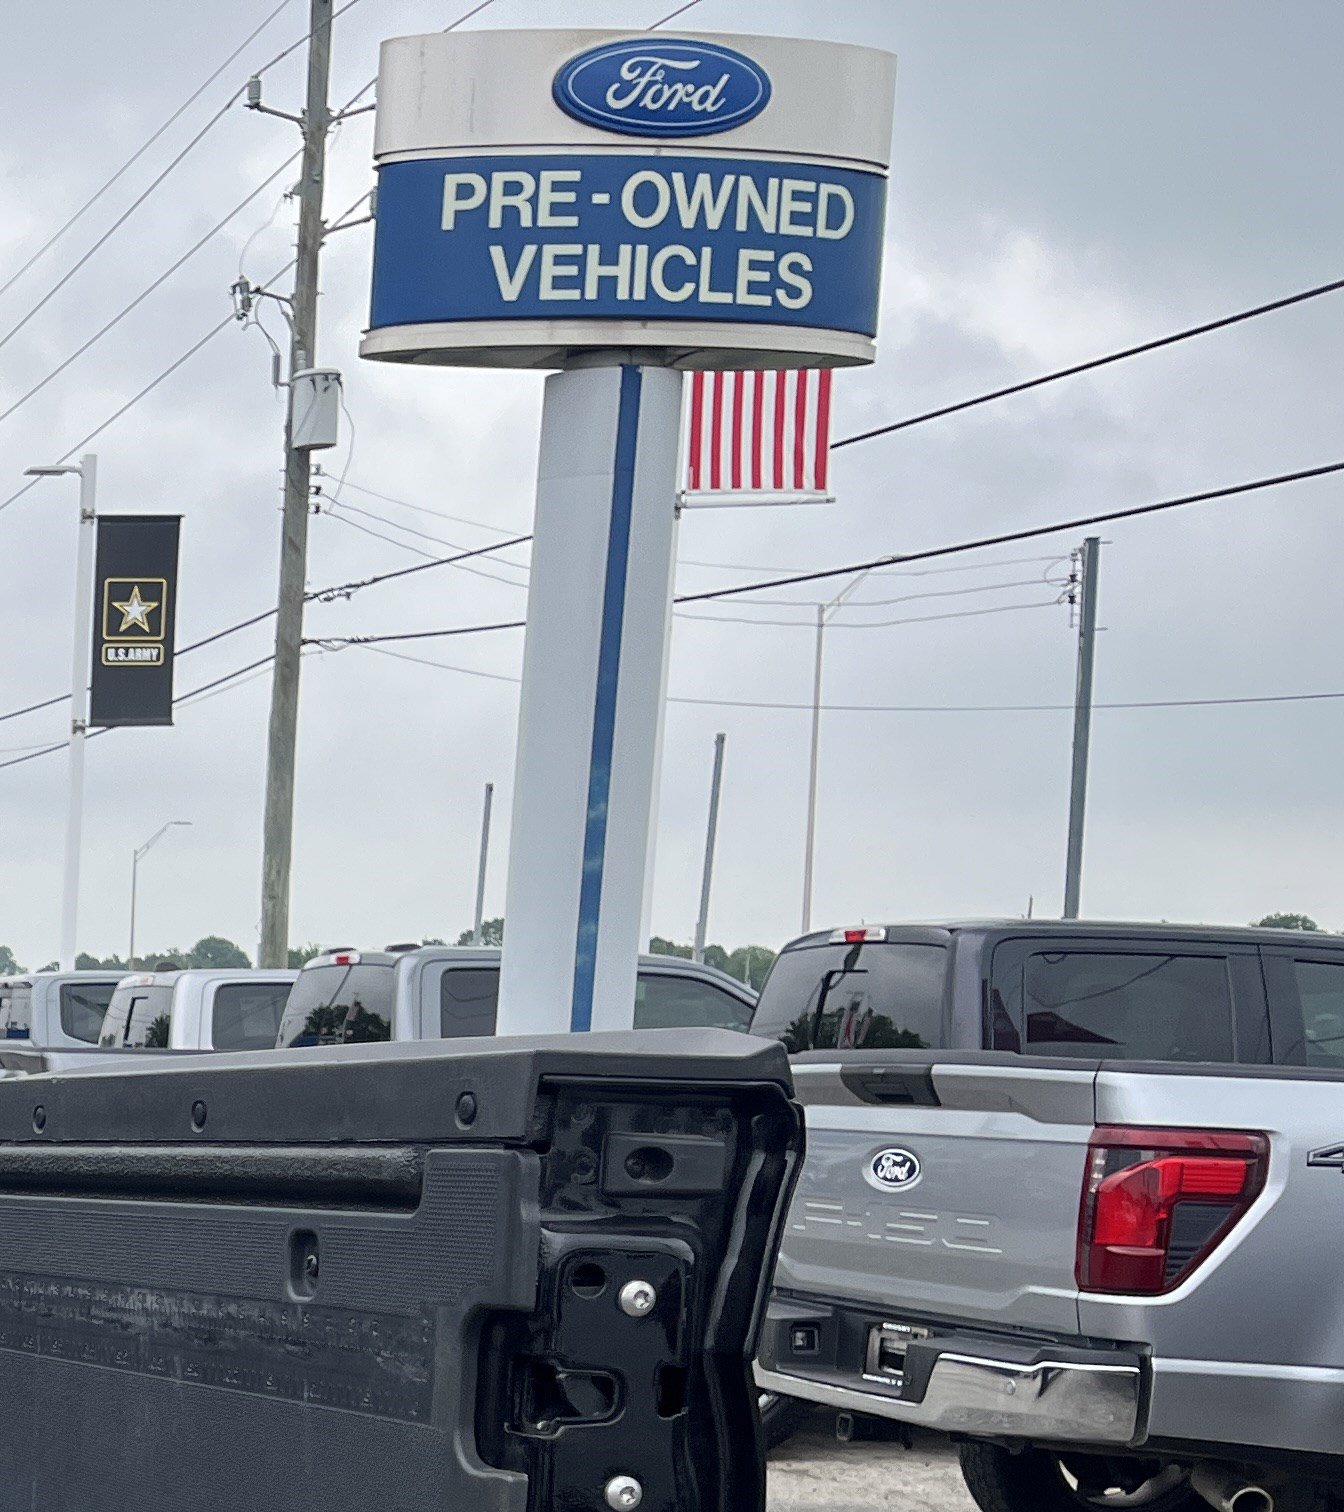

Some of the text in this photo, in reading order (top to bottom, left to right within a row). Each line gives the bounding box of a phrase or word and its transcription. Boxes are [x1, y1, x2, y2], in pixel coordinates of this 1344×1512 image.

[605, 55, 729, 113] Ford
[489, 243, 814, 310] VEHICLES
[877, 1152, 912, 1181] Ford
